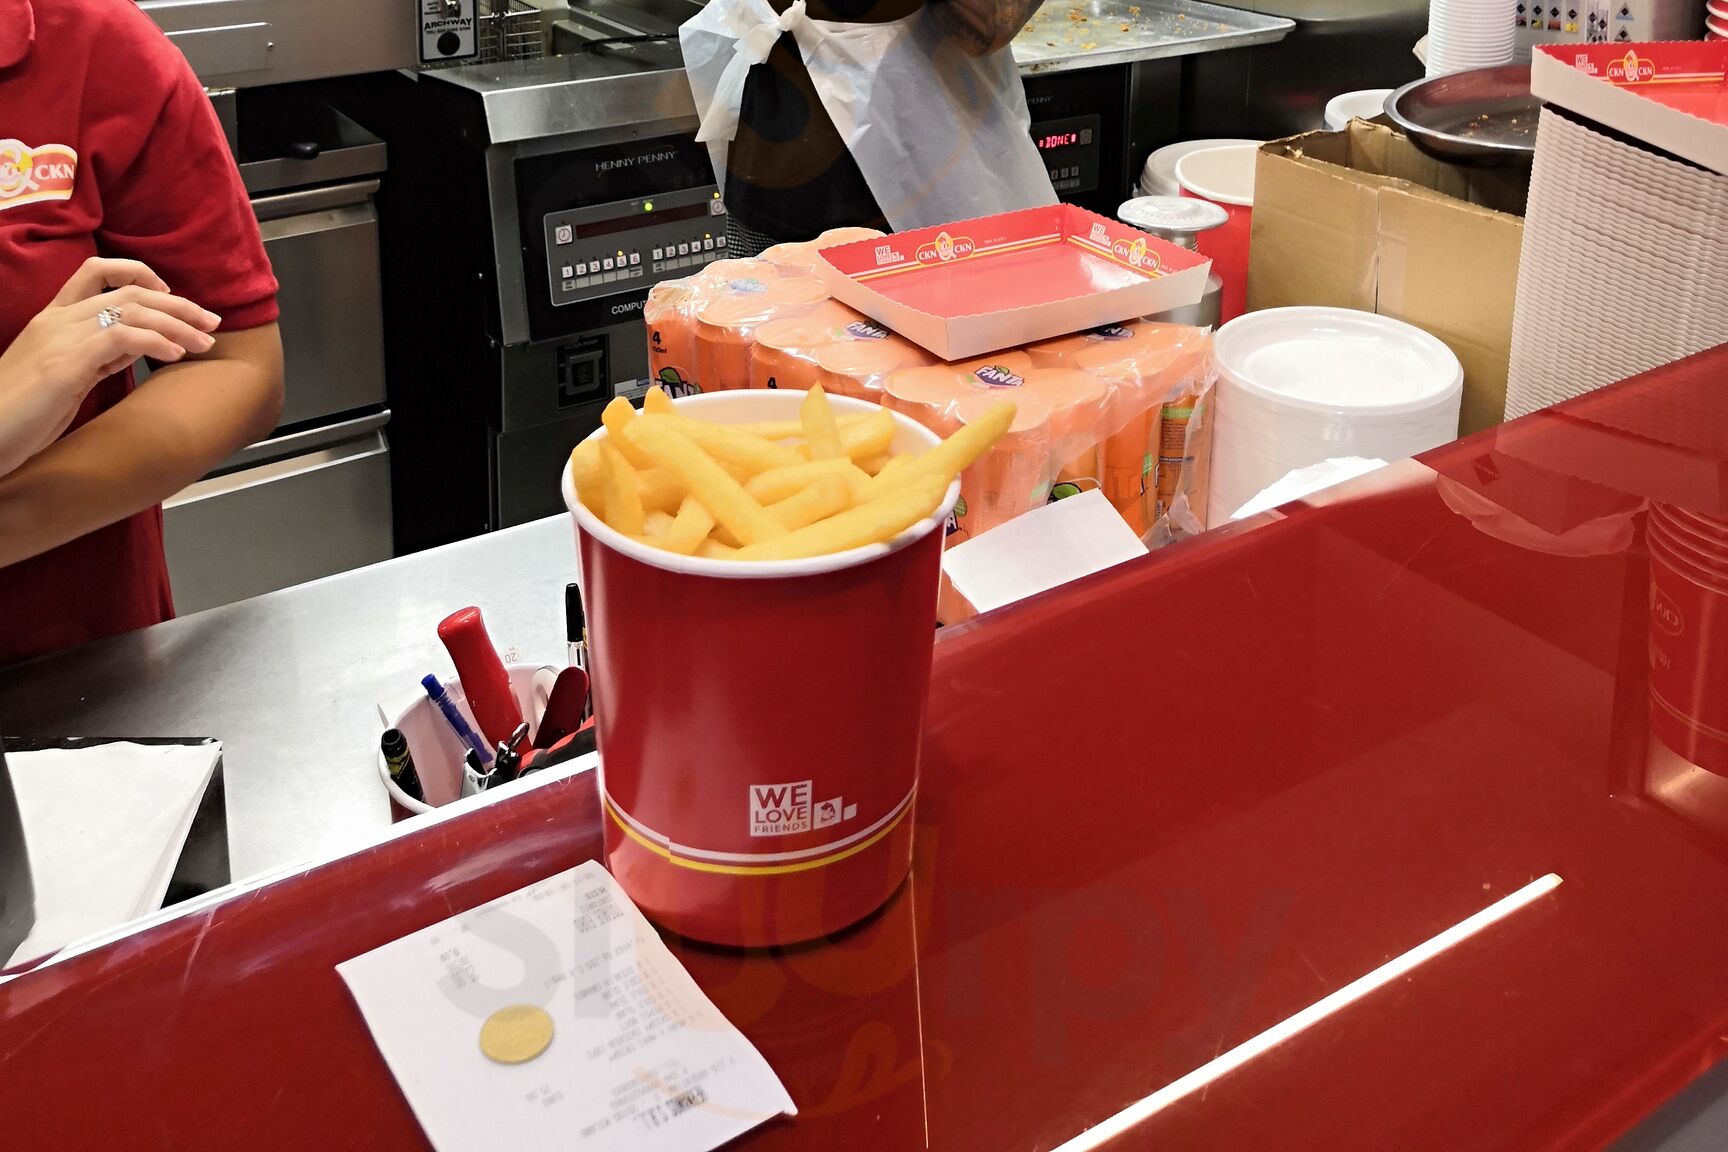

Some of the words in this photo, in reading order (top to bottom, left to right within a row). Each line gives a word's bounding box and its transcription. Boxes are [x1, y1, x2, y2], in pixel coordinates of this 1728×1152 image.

[424, 18, 473, 31] ARCHWAY
[1609, 67, 1624, 77] CKN
[1638, 65, 1653, 76] CKN
[595, 157, 636, 172] HENNY
[637, 151, 675, 165] PENNY
[34, 163, 75, 180] CKN
[918, 249, 938, 261] CKN
[954, 242, 972, 254] CKN
[1114, 244, 1130, 257] CKN
[1142, 255, 1158, 269] CKN
[652, 330, 662, 345] 4
[767, 377, 777, 389] 4
[754, 783, 808, 810] WE
[755, 805, 808, 824] LOVE
[754, 821, 808, 833] FRIENDS
